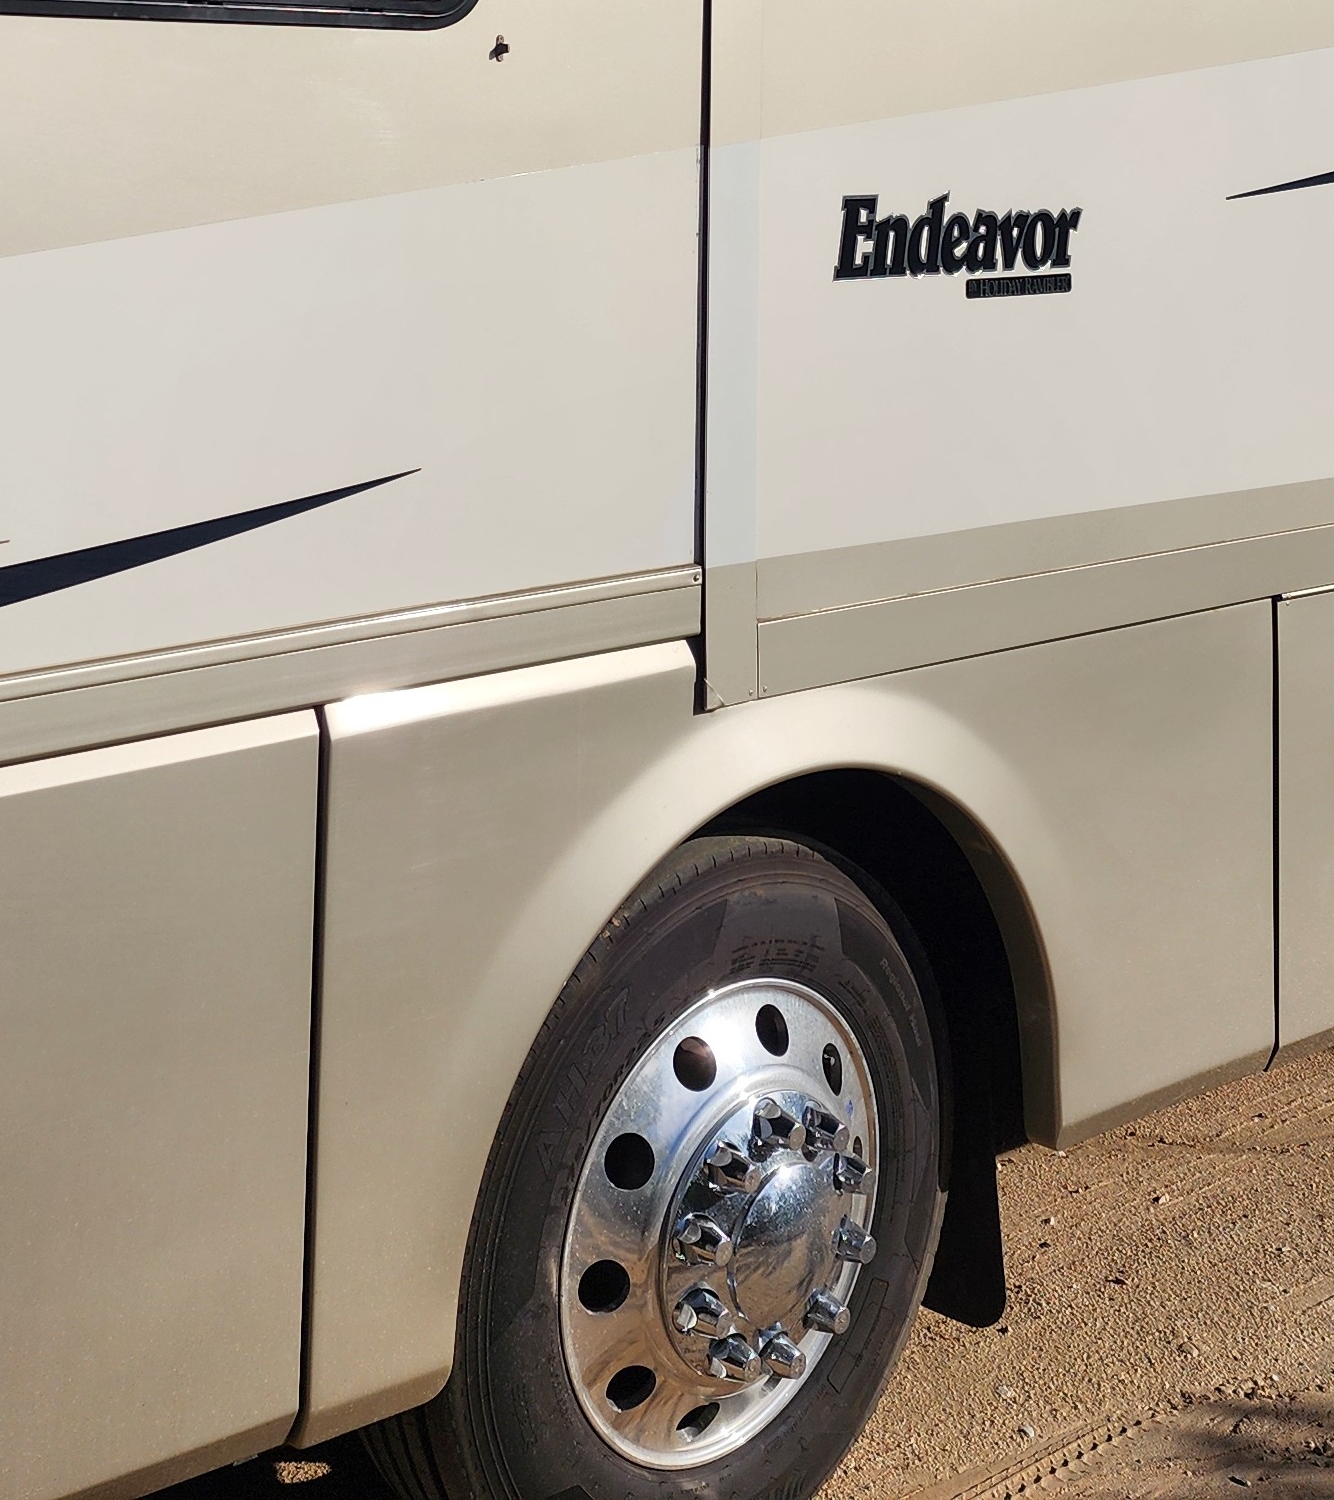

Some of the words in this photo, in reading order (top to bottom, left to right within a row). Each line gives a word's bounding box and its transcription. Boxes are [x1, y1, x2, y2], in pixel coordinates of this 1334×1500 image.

[833, 190, 1083, 282] Endeavor
[980, 279, 1024, 297] HOLIDAY
[1025, 276, 1069, 295] RAMBLER
